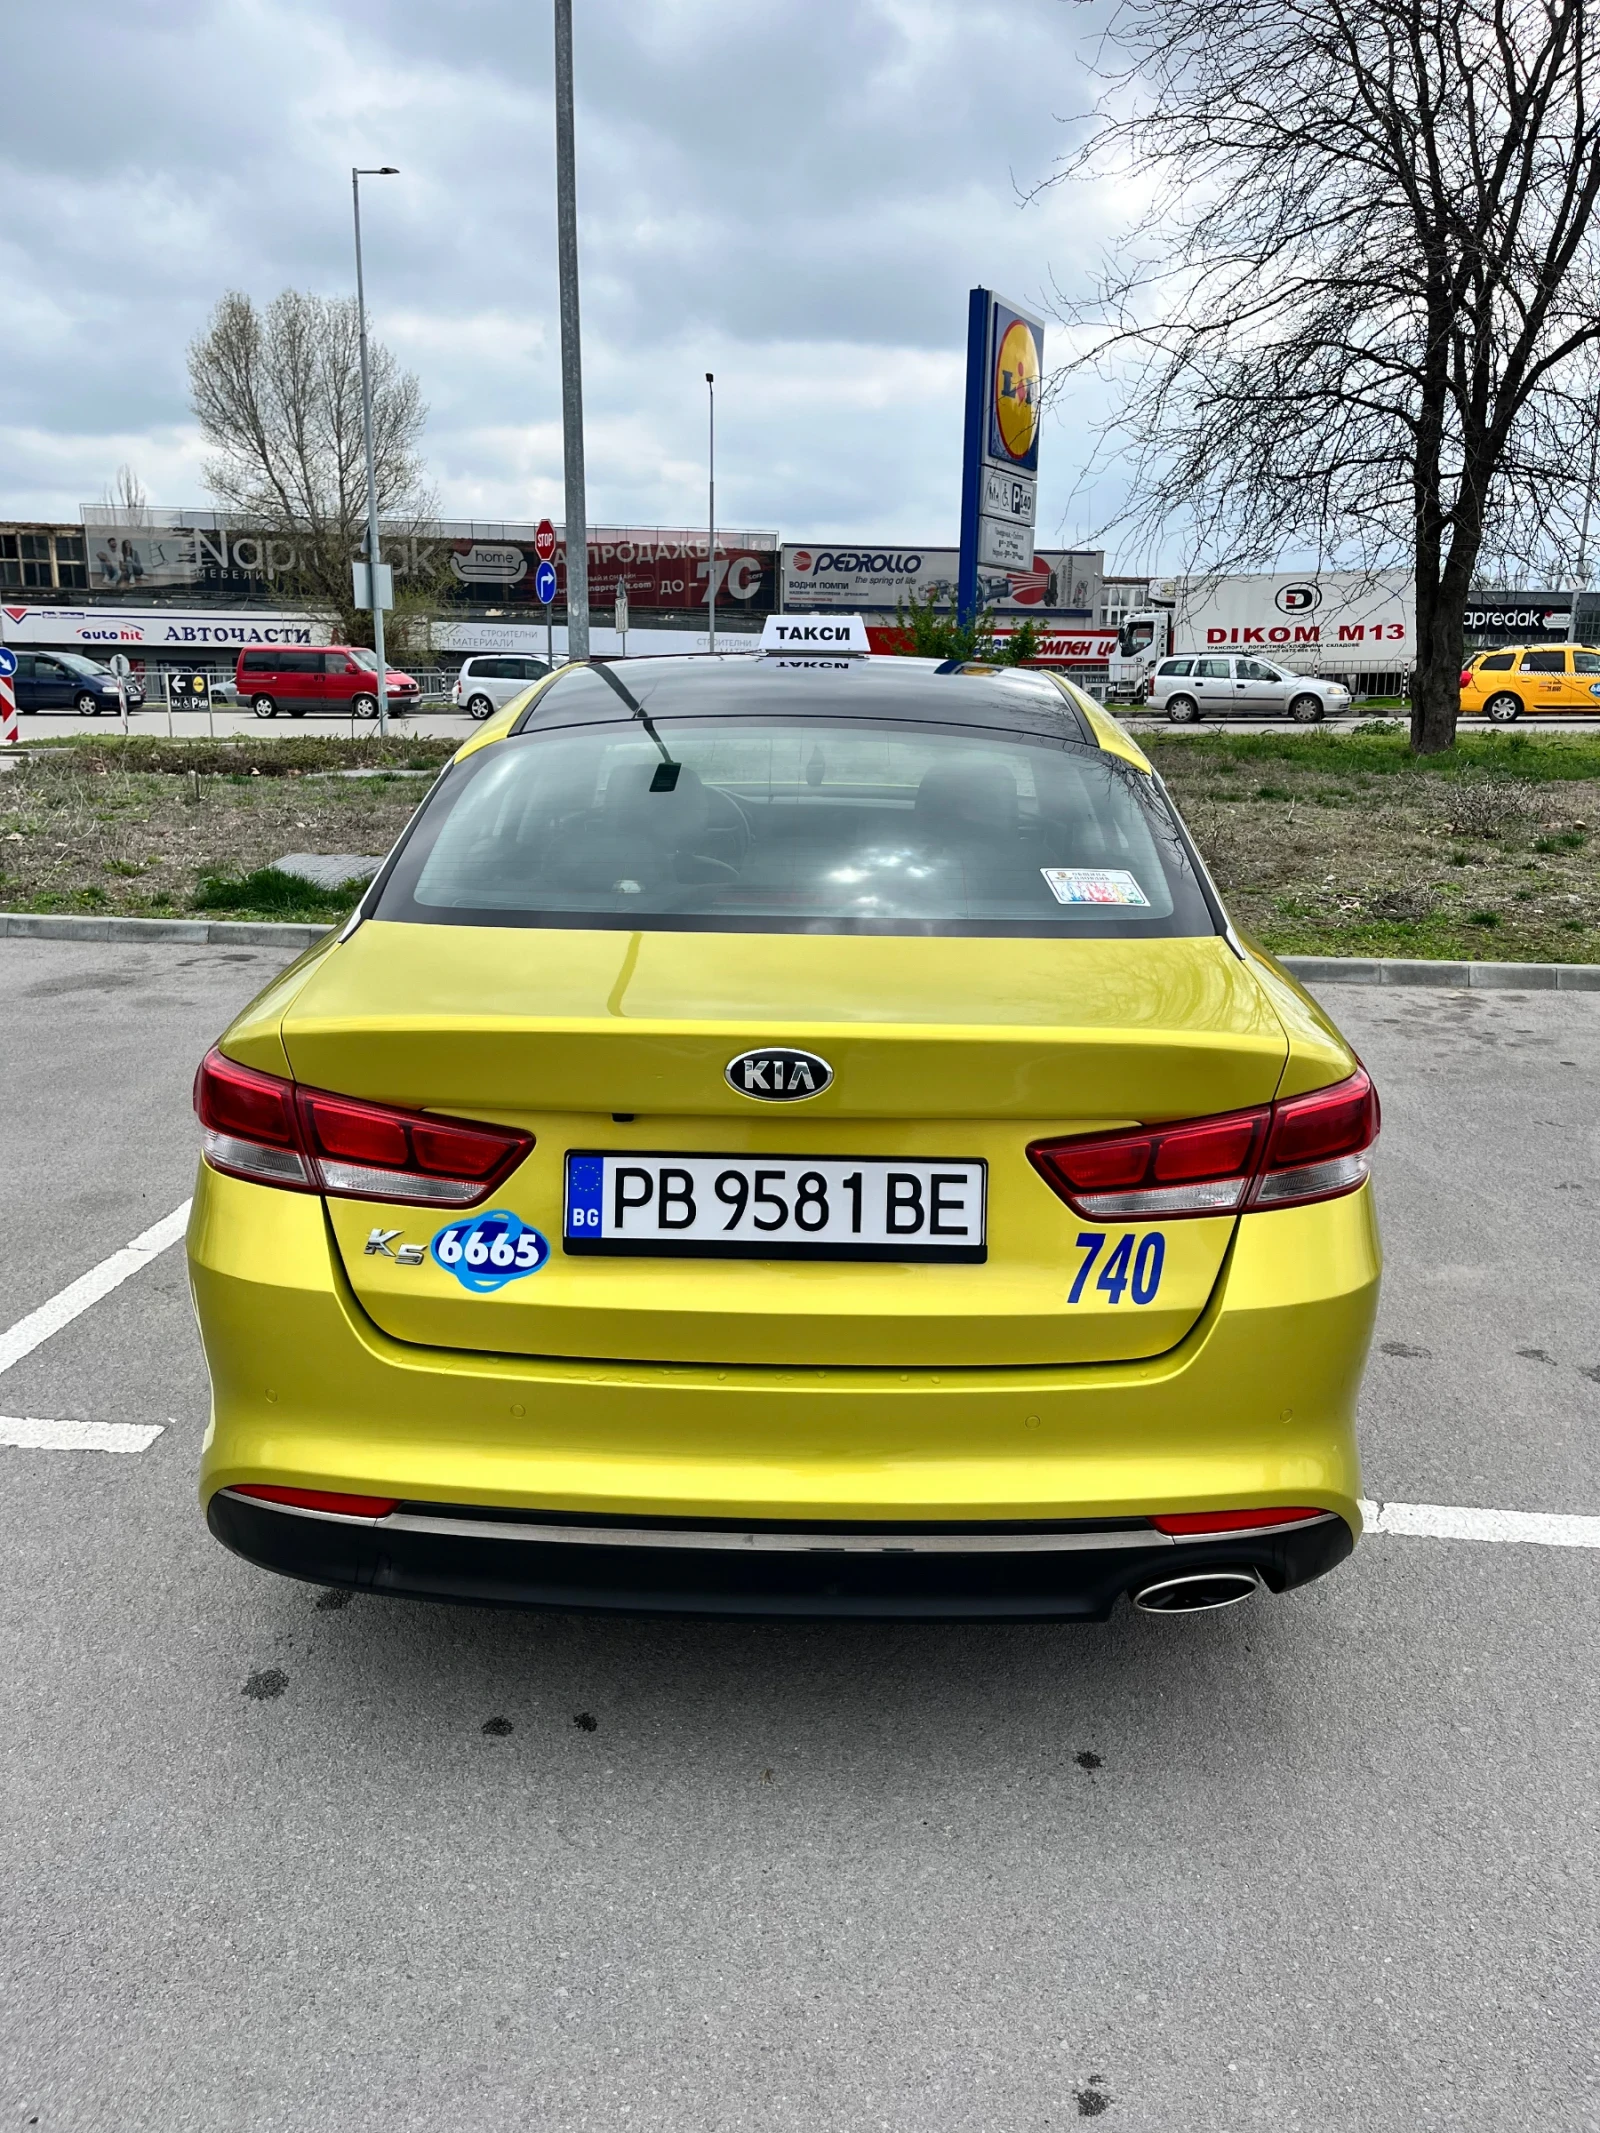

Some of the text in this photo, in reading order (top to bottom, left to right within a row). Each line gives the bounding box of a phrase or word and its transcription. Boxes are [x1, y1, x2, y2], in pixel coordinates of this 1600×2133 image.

[537, 533, 553, 547] STOP
[475, 550, 514, 563] home
[812, 552, 922, 577] PEDROLLO
[196, 568, 264, 580] МЕБЕЛИ
[855, 576, 917, 586] the spring of life
[660, 580, 684, 595] ДО
[789, 581, 849, 590] ВОДНИ ПОМПИ
[82, 630, 143, 640] auto hit
[164, 626, 312, 644] АВТОЧАСТИ
[481, 629, 538, 638] СТРОИТЕЛНИ
[776, 627, 850, 640] ТАКСИ
[1207, 624, 1405, 643] DIKOM M13
[452, 637, 514, 647] МАТЕРИАЛИ
[744, 1060, 815, 1090] KIA
[614, 1167, 968, 1236] PB 9581 BE
[573, 1209, 599, 1226] BG
[364, 1228, 428, 1265] K5
[438, 1230, 539, 1268] 6665
[1067, 1232, 1166, 1304] 740
